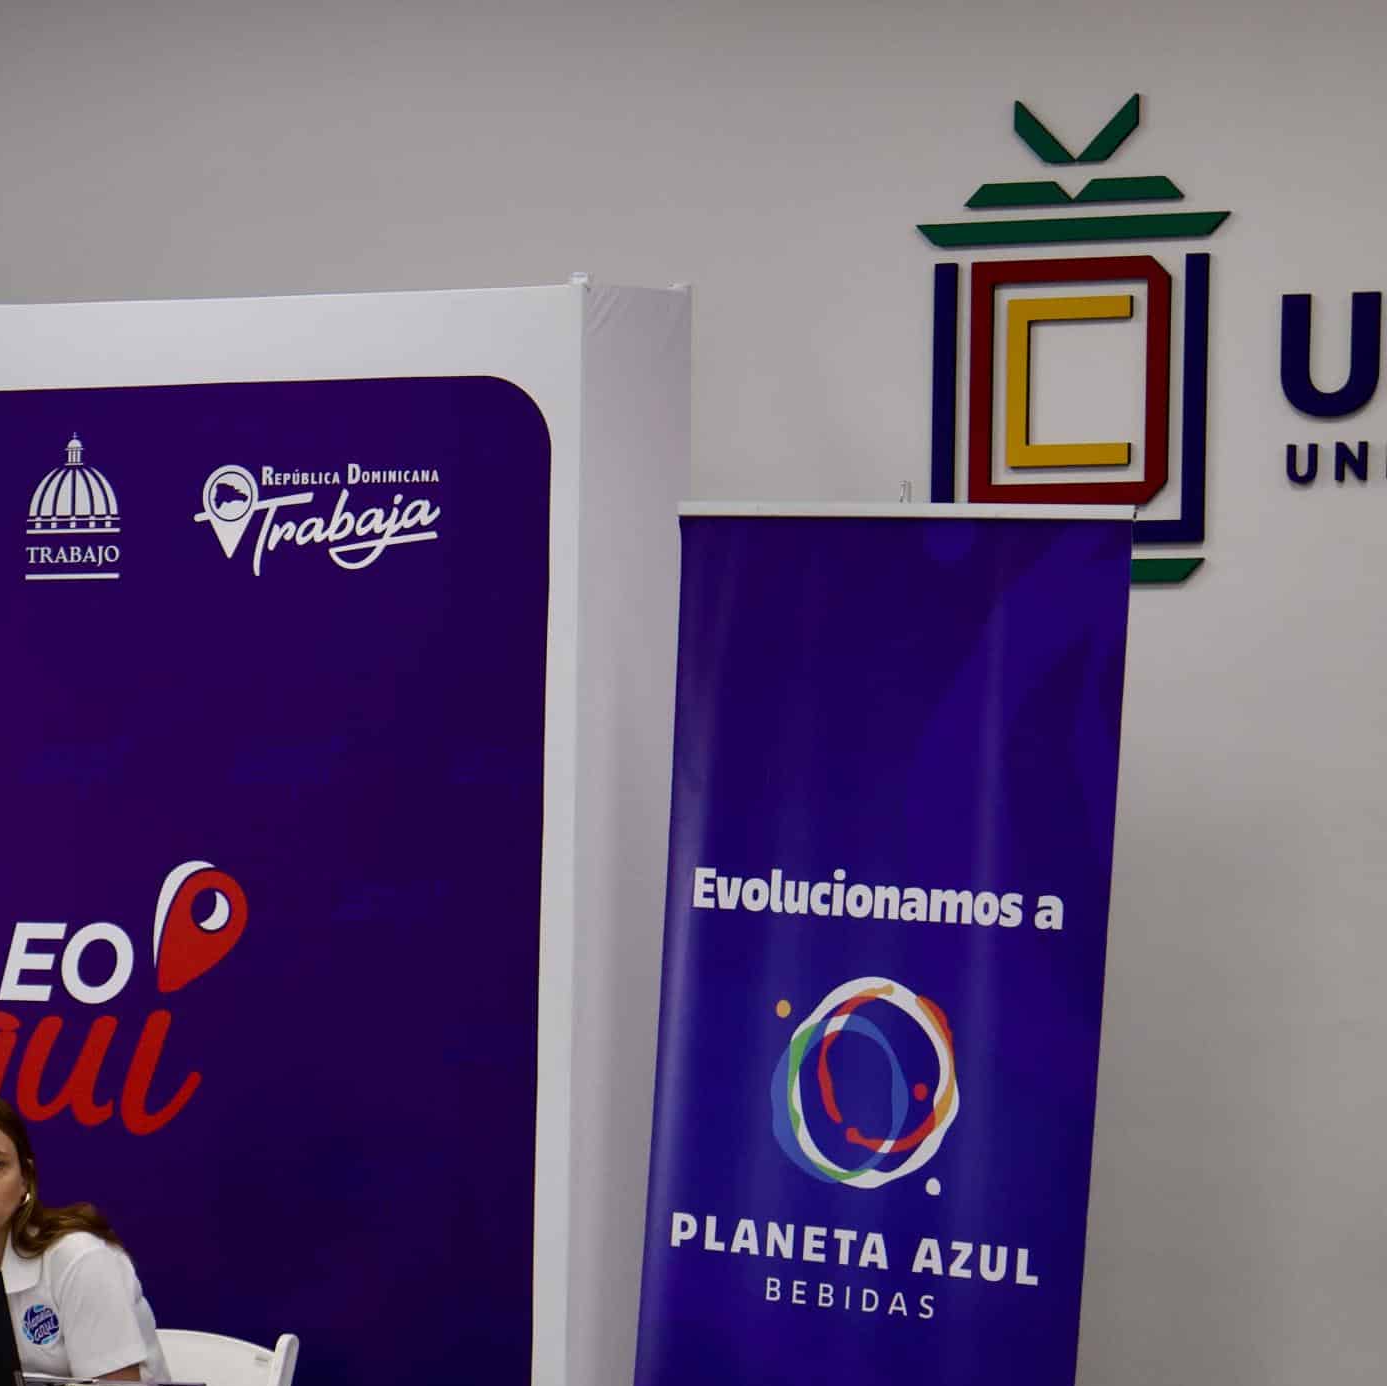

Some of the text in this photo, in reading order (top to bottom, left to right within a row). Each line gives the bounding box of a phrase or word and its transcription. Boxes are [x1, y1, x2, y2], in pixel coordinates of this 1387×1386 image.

[1280, 291, 1383, 419] U
[347, 463, 440, 485] DOMINICANA
[26, 545, 120, 567] TRABAJO
[252, 488, 442, 577] Trabaja
[692, 867, 1065, 930] Evolucionamos a
[670, 1211, 1039, 1286] PLANETA AZUL
[765, 1277, 936, 1319] BEBIDAS
